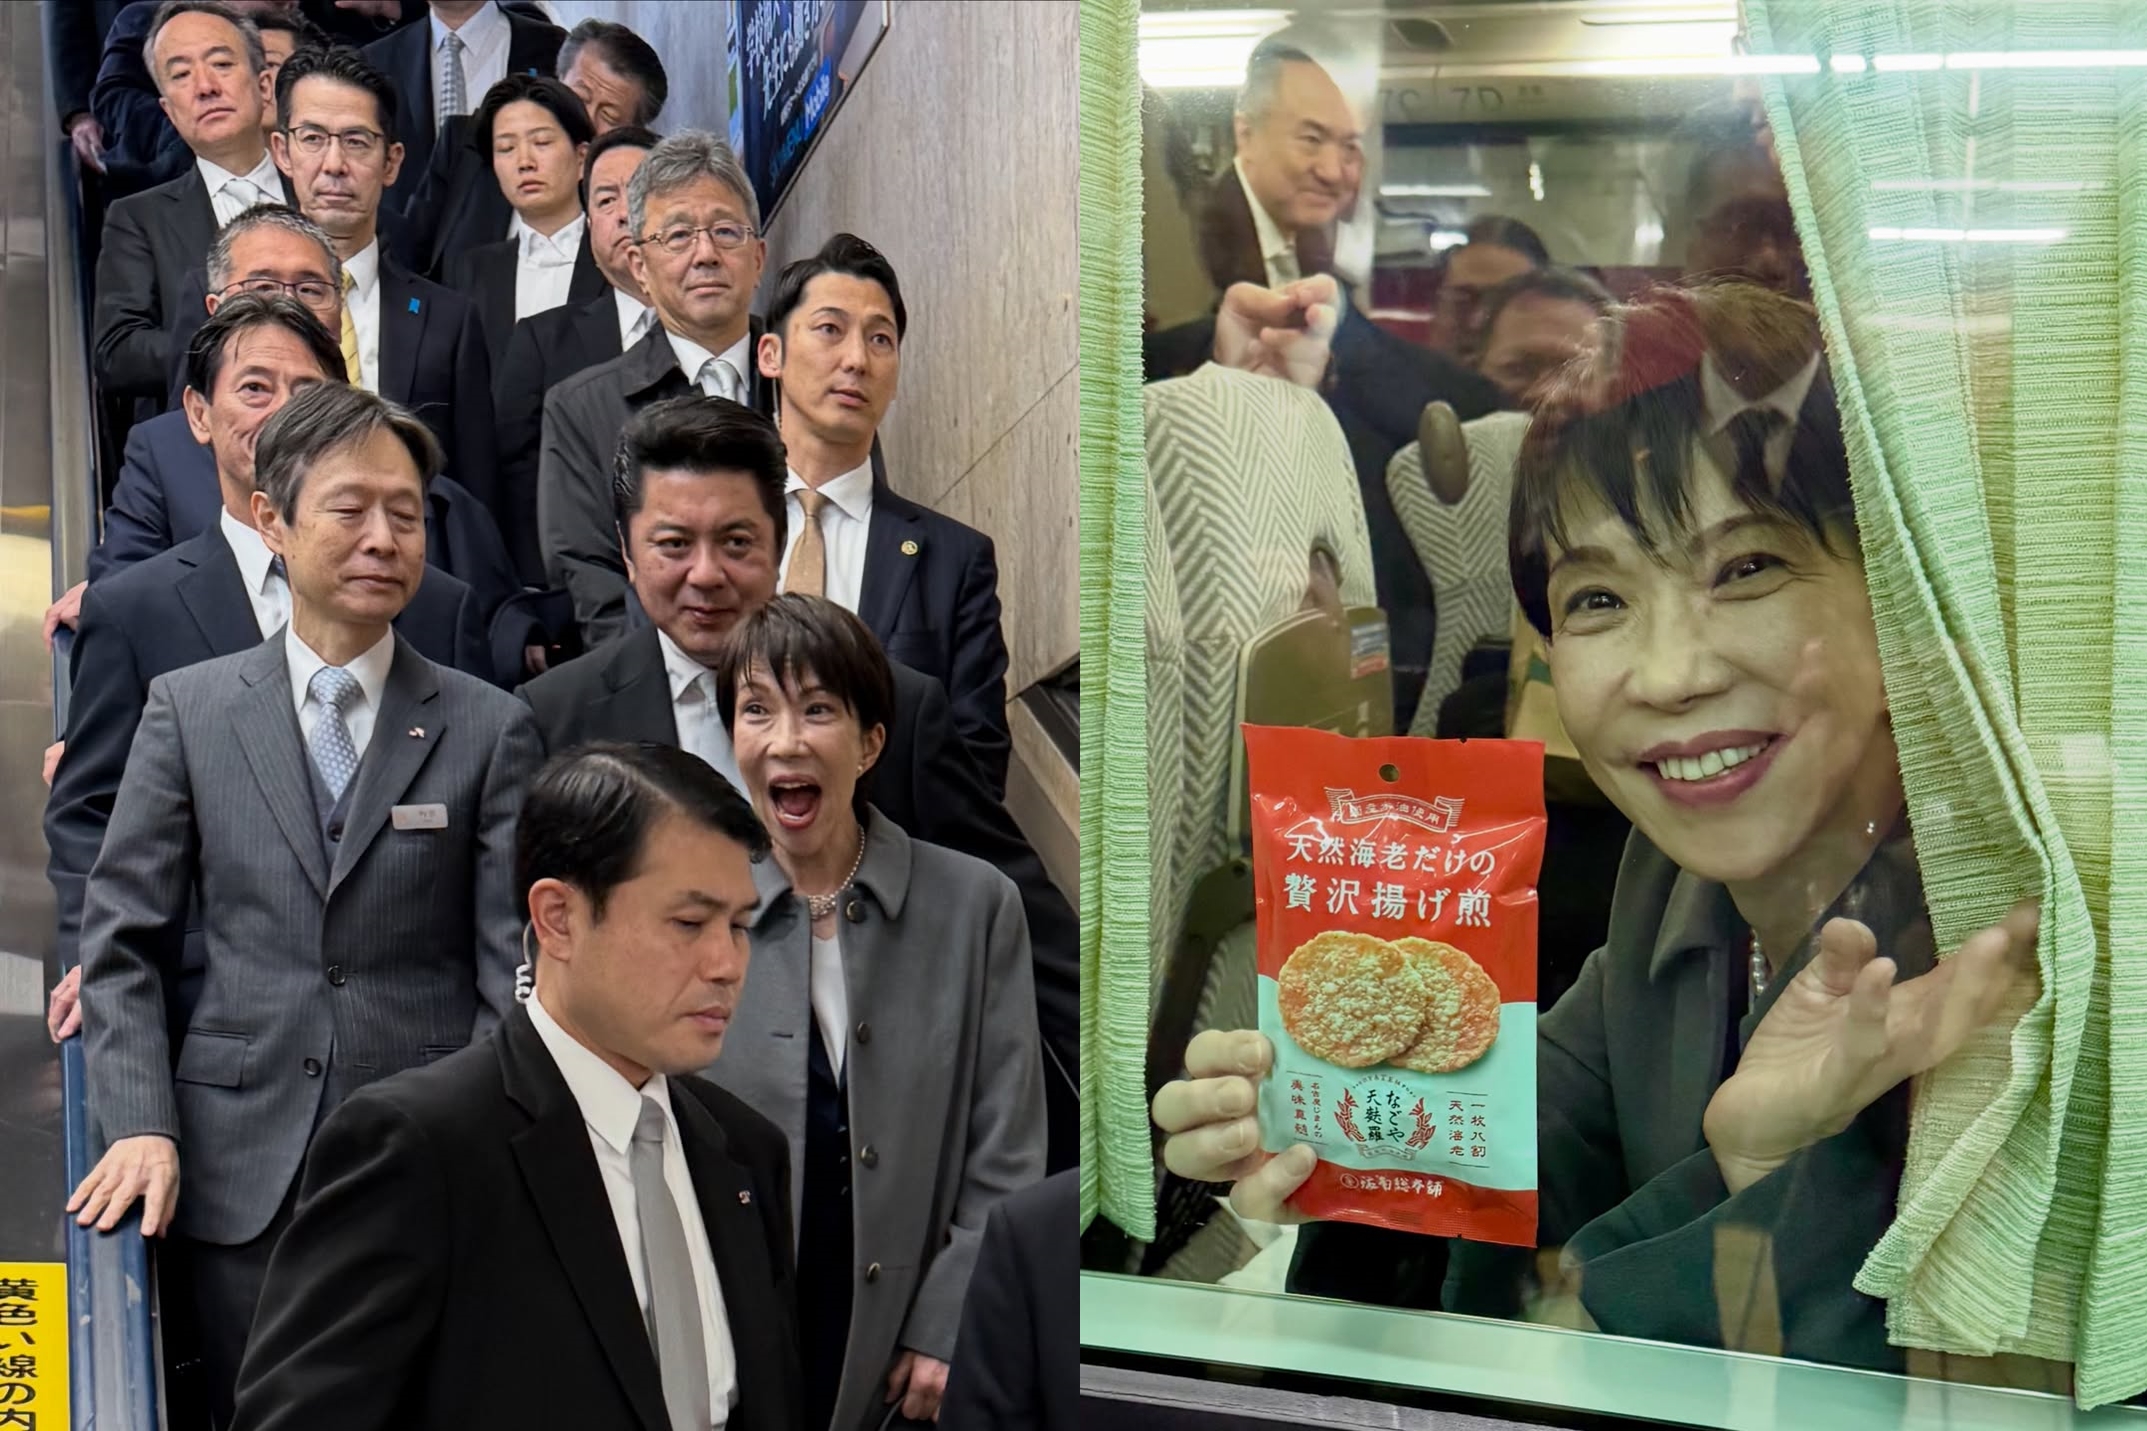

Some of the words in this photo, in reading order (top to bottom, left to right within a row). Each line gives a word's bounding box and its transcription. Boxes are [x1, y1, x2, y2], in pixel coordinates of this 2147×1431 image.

[1286, 836, 1496, 876] 天然海老だけの
[1283, 872, 1492, 928] 贅沢揚げ煎
[1365, 1089, 1384, 1142] 天麩羅
[1386, 1090, 1405, 1143] なごや
[1448, 1100, 1464, 1157] 天然海老
[1470, 1103, 1486, 1158] 一枚八割
